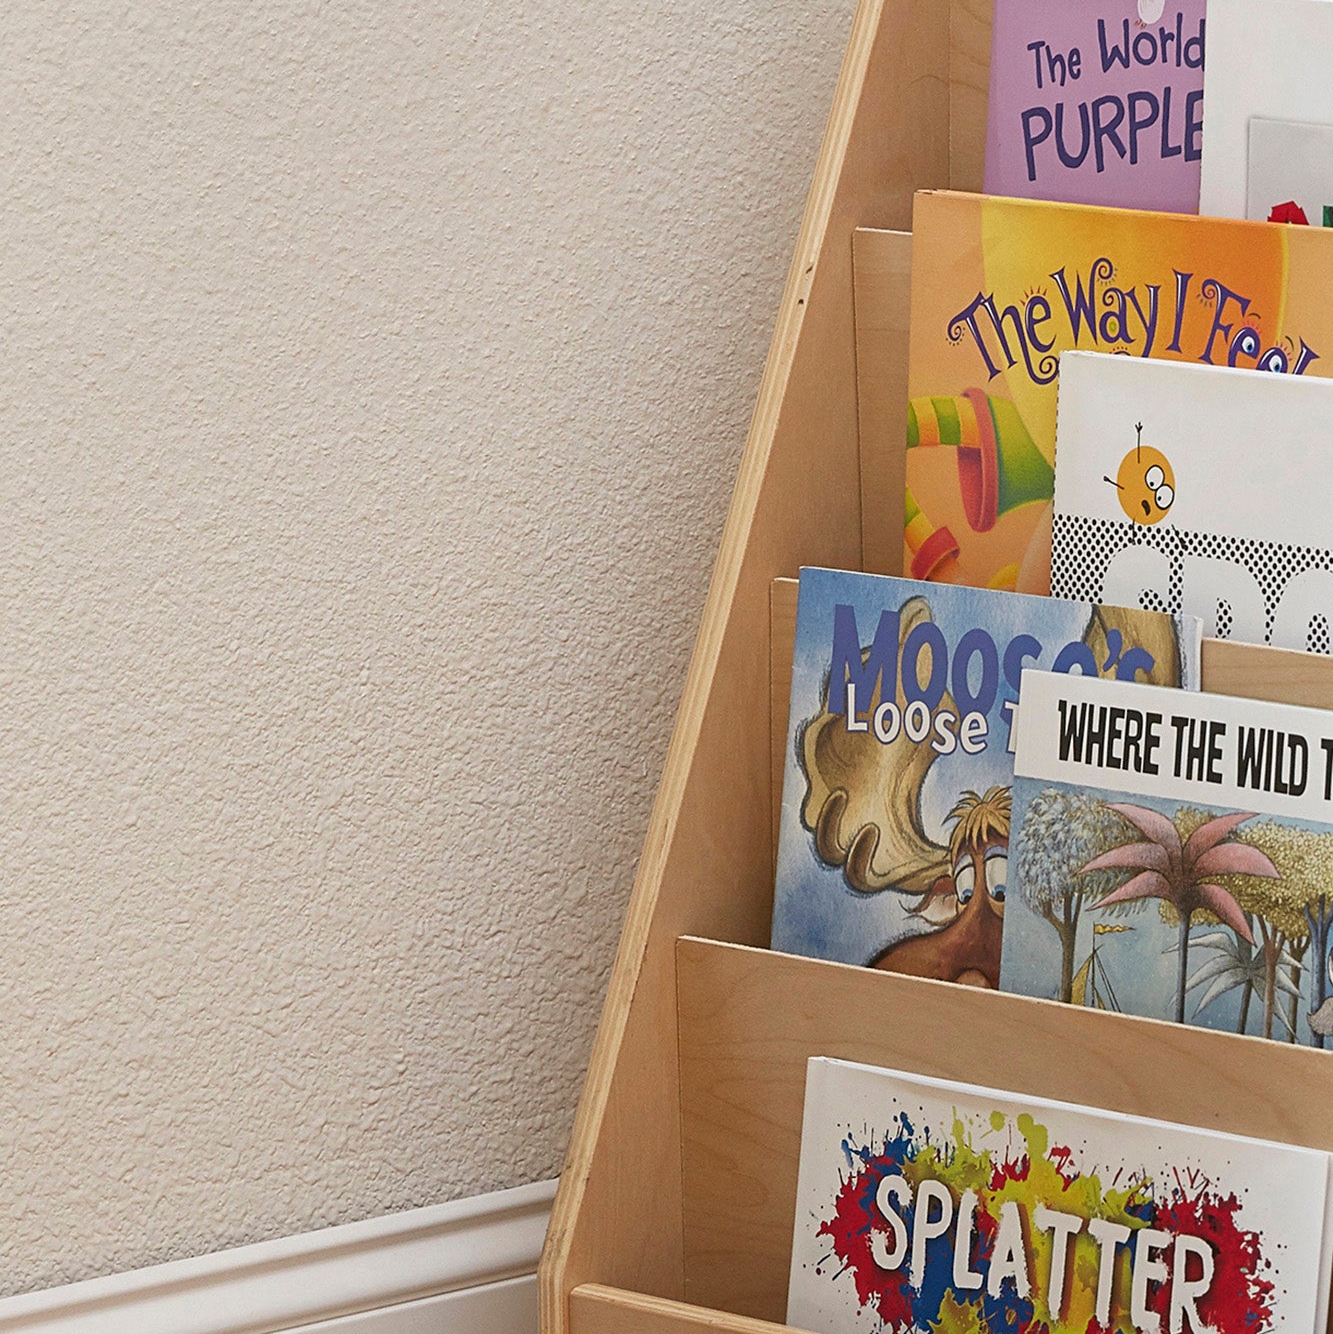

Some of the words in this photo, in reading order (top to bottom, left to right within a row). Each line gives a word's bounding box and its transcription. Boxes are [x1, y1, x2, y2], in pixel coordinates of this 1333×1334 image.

[1027, 40, 1081, 89] The
[1097, 12, 1206, 73] World
[1021, 86, 1204, 182] PURPLE
[946, 290, 1060, 385] The
[1049, 257, 1162, 358] Way
[1166, 267, 1194, 354] I
[846, 682, 989, 756] Loose
[1058, 699, 1163, 776] WHERE
[1171, 715, 1227, 785] THE
[1236, 725, 1309, 797] WILD
